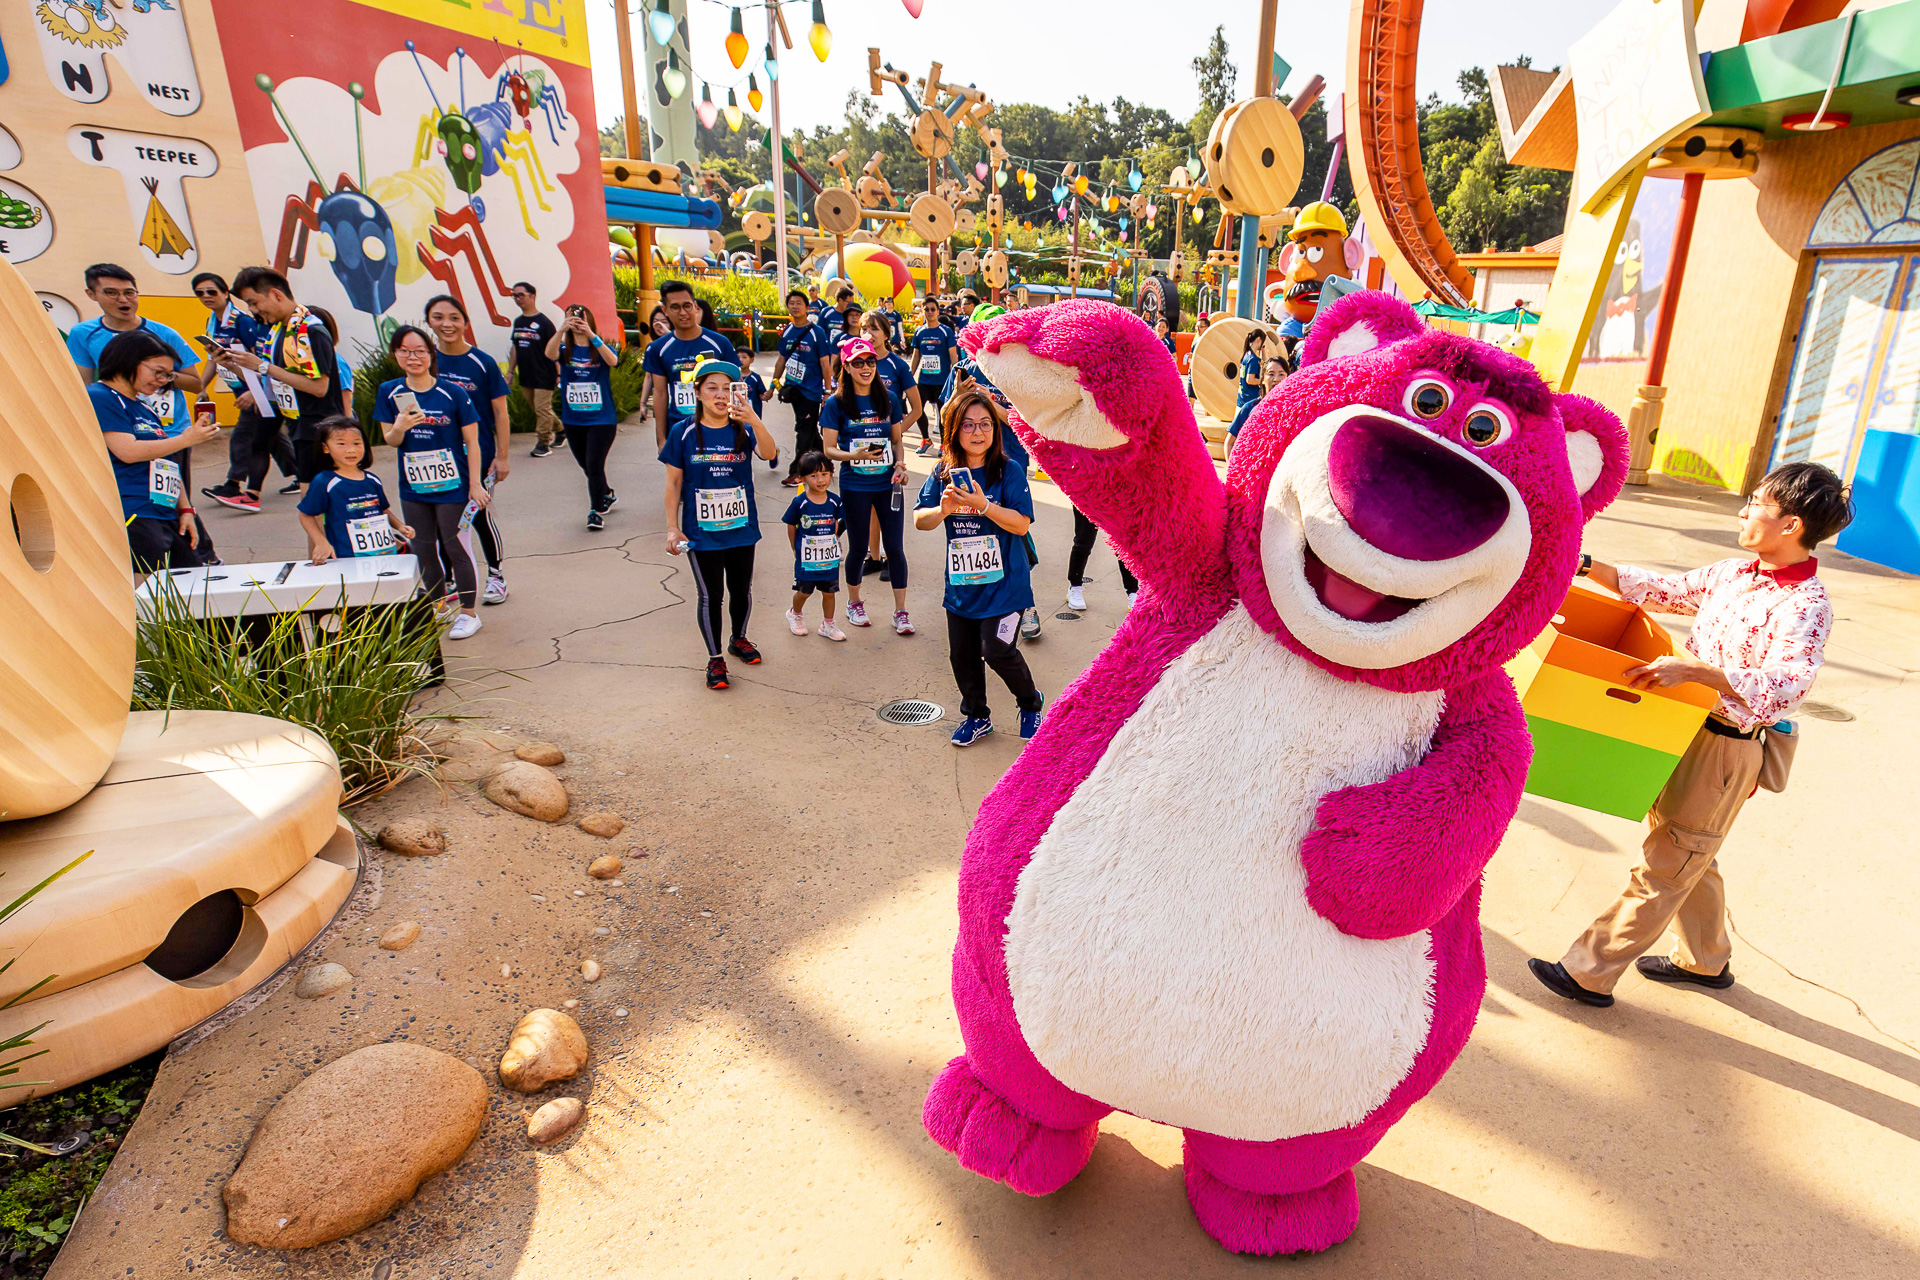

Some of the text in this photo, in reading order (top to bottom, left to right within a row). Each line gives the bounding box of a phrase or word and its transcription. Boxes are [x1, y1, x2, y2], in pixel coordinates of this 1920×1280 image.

[61, 60, 93, 94] N
[147, 83, 190, 101] NEST
[1592, 64, 1652, 140] TOY
[80, 131, 104, 162] T
[1594, 104, 1657, 180] BOX
[134, 146, 198, 166] TEEPEE
[570, 391, 599, 403] B11517
[408, 462, 456, 482] B11785
[700, 500, 746, 519] B11480
[804, 544, 840, 561] B11302
[951, 550, 1000, 572] B11484
